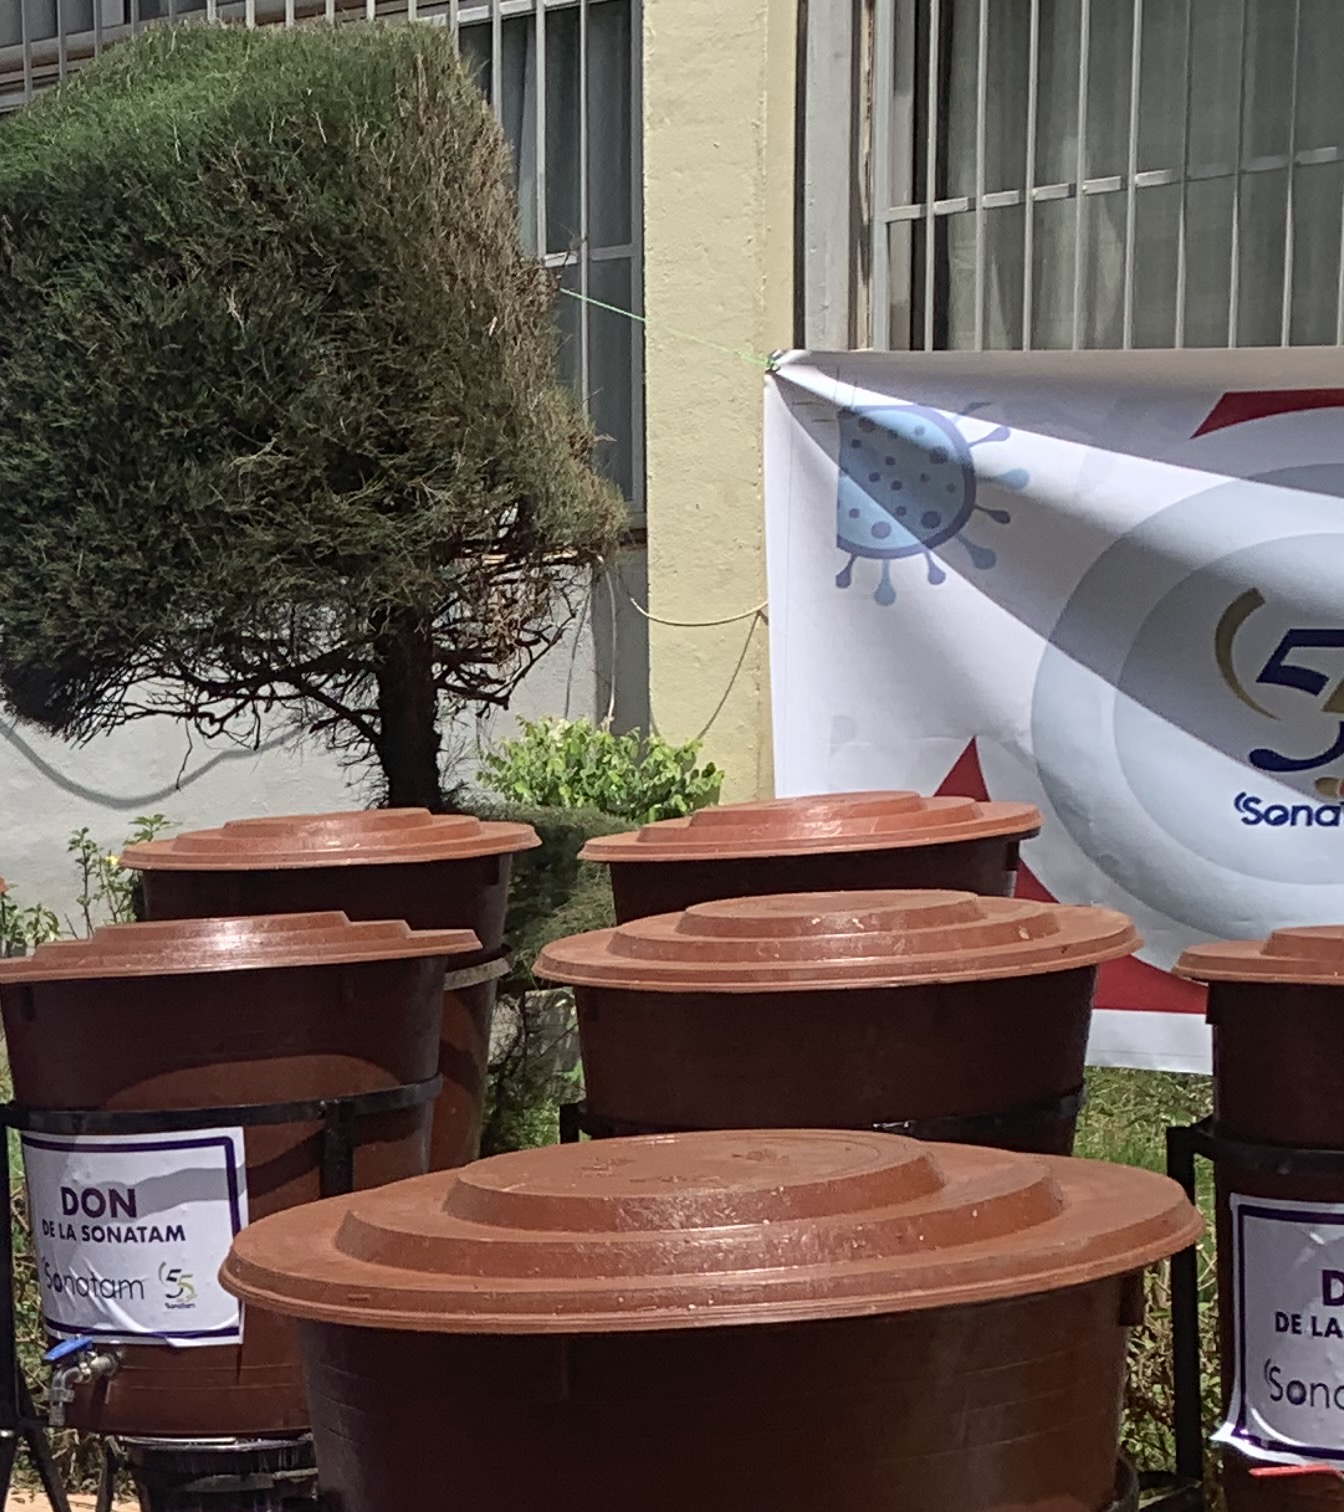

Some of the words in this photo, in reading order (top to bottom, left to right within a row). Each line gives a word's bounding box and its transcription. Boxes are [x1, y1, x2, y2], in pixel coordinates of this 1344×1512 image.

[1234, 792, 1344, 827] Sona
[60, 1186, 138, 1218] DON
[42, 1219, 56, 1238] DE
[58, 1222, 77, 1241] LA
[81, 1224, 186, 1243] SONATAM
[42, 1257, 145, 1300] Sonatam
[160, 1263, 197, 1300] 55
[1275, 1311, 1302, 1335] DE
[1311, 1315, 1344, 1339] LA
